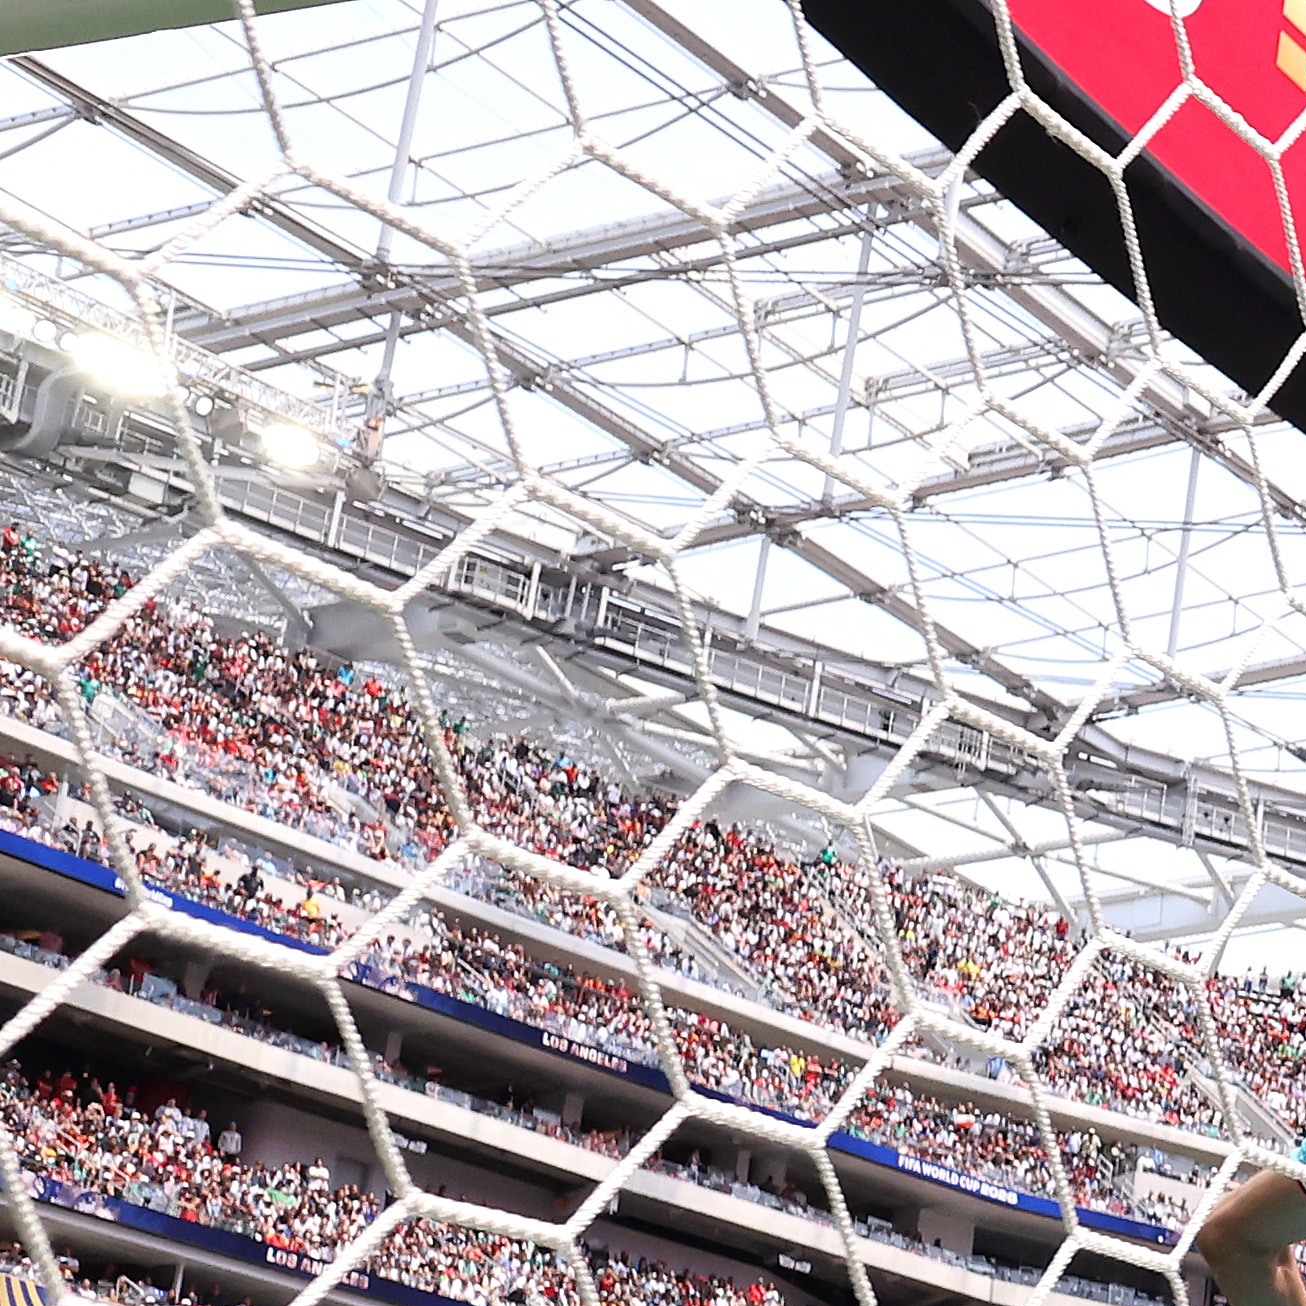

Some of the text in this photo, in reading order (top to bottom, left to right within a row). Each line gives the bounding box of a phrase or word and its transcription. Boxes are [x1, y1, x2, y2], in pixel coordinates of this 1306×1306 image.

[542, 1031, 628, 1073] LOS ANGELES
[898, 1154, 1018, 1205] FIFA WORLD CUP 2026
[266, 1246, 370, 1290] LOS ANLES
